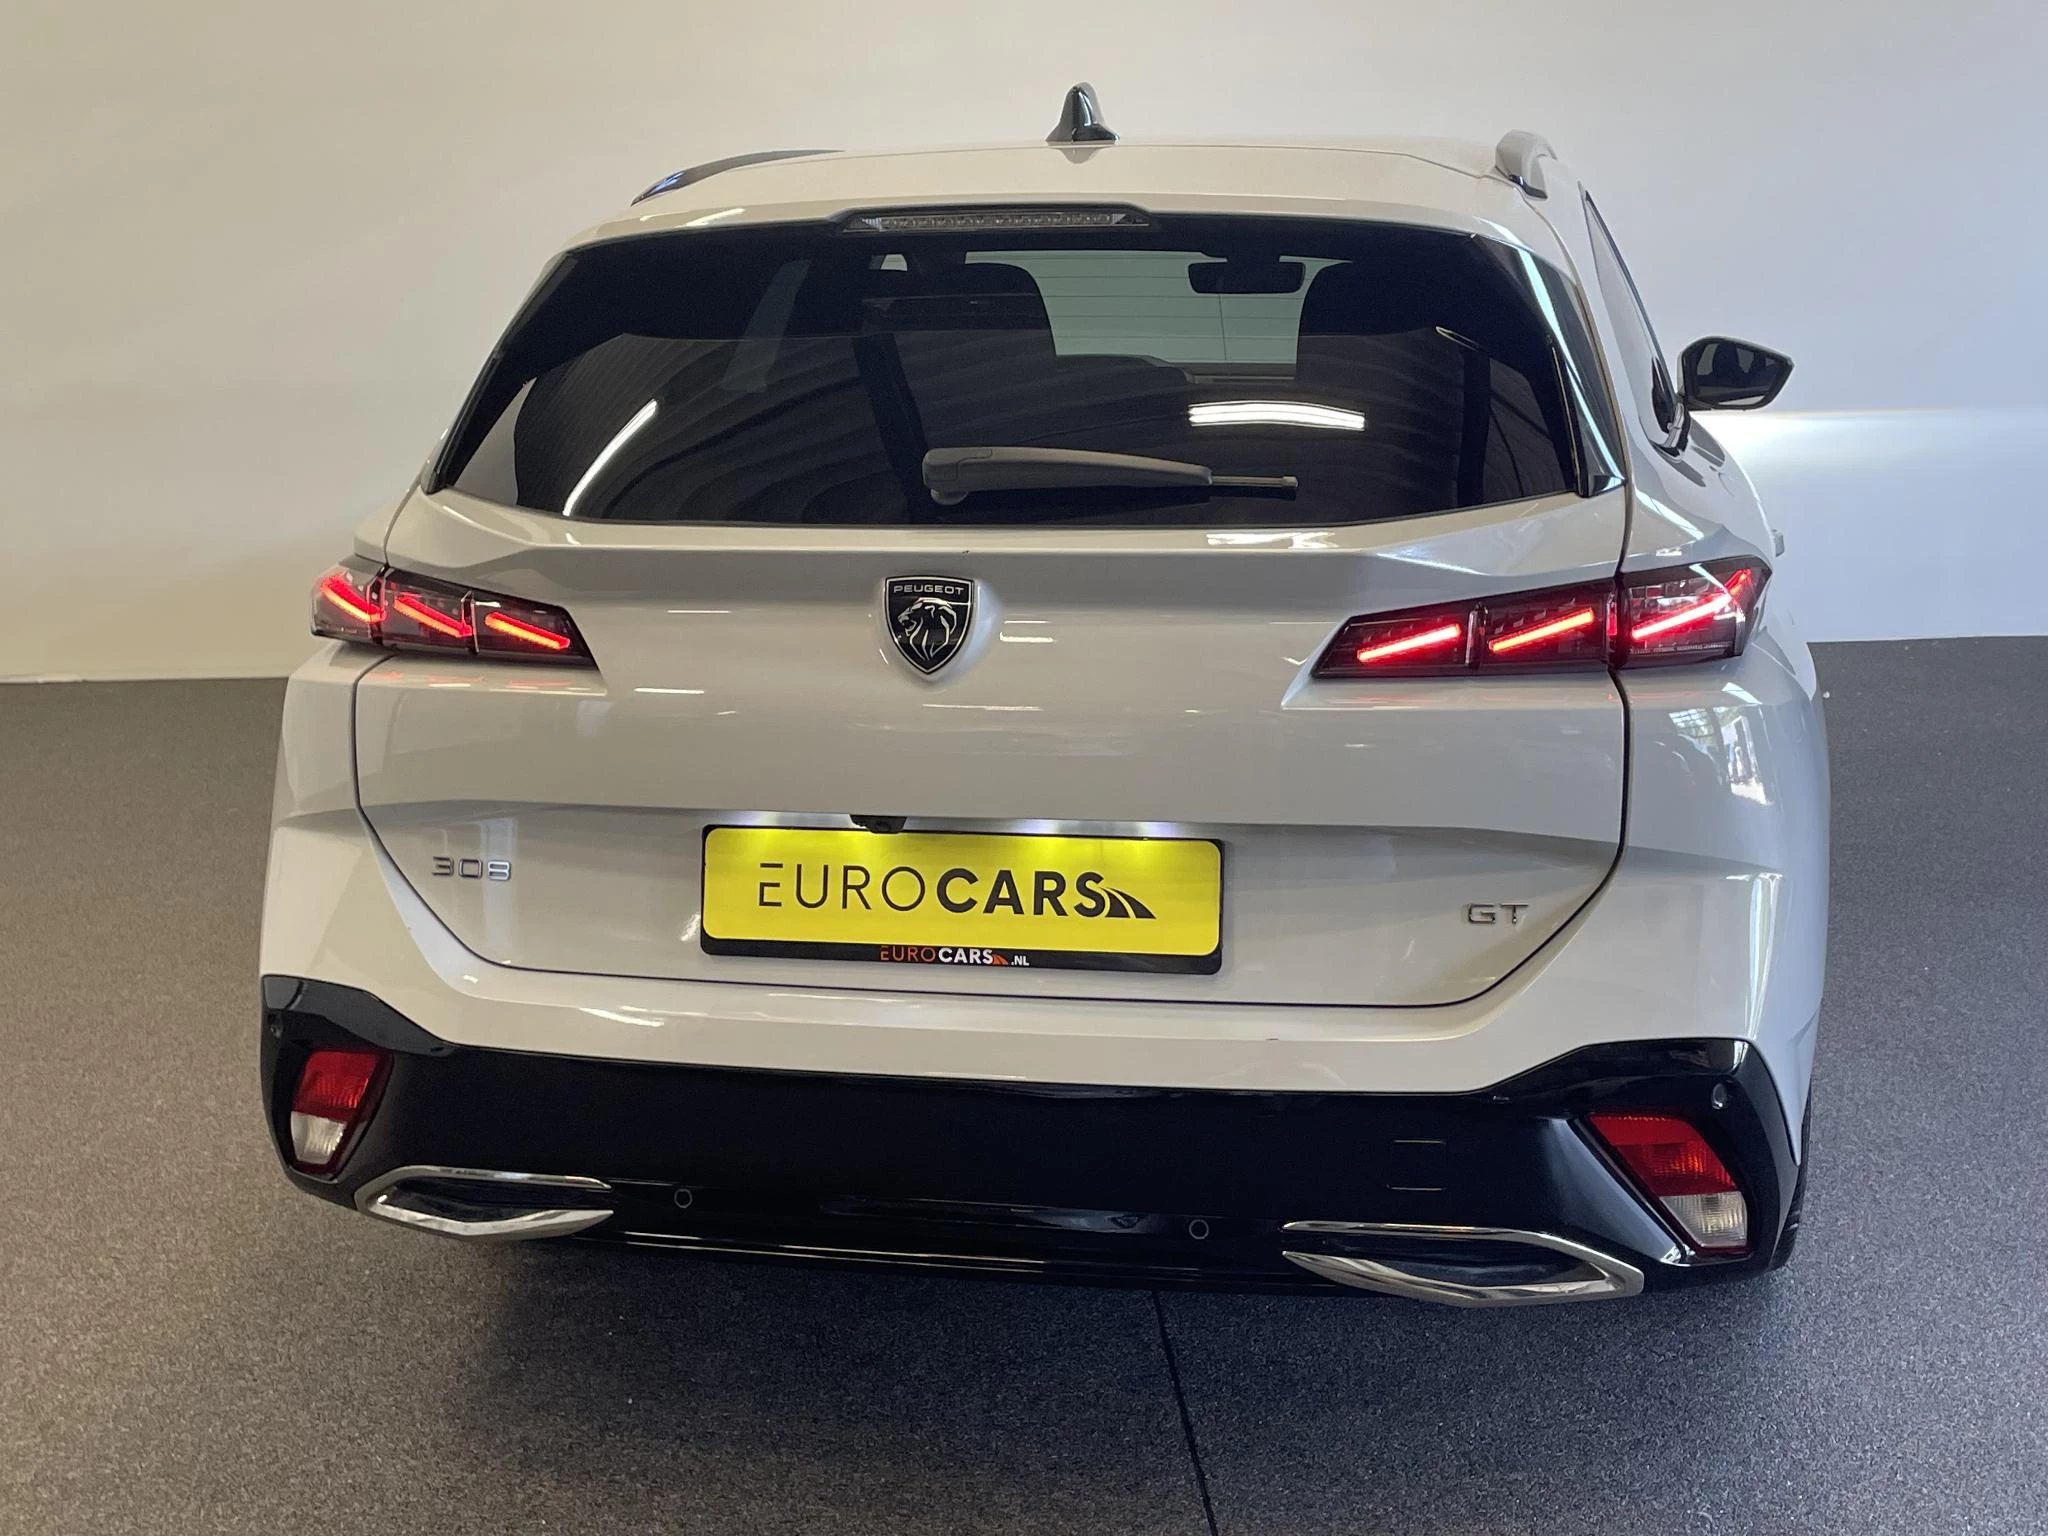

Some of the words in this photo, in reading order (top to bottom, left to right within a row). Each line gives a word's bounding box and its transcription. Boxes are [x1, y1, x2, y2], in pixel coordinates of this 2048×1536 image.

[893, 584, 964, 595] PEUGEOT
[432, 856, 512, 881] 308
[758, 862, 1106, 918] EUROCARS
[1467, 903, 1528, 925] GT
